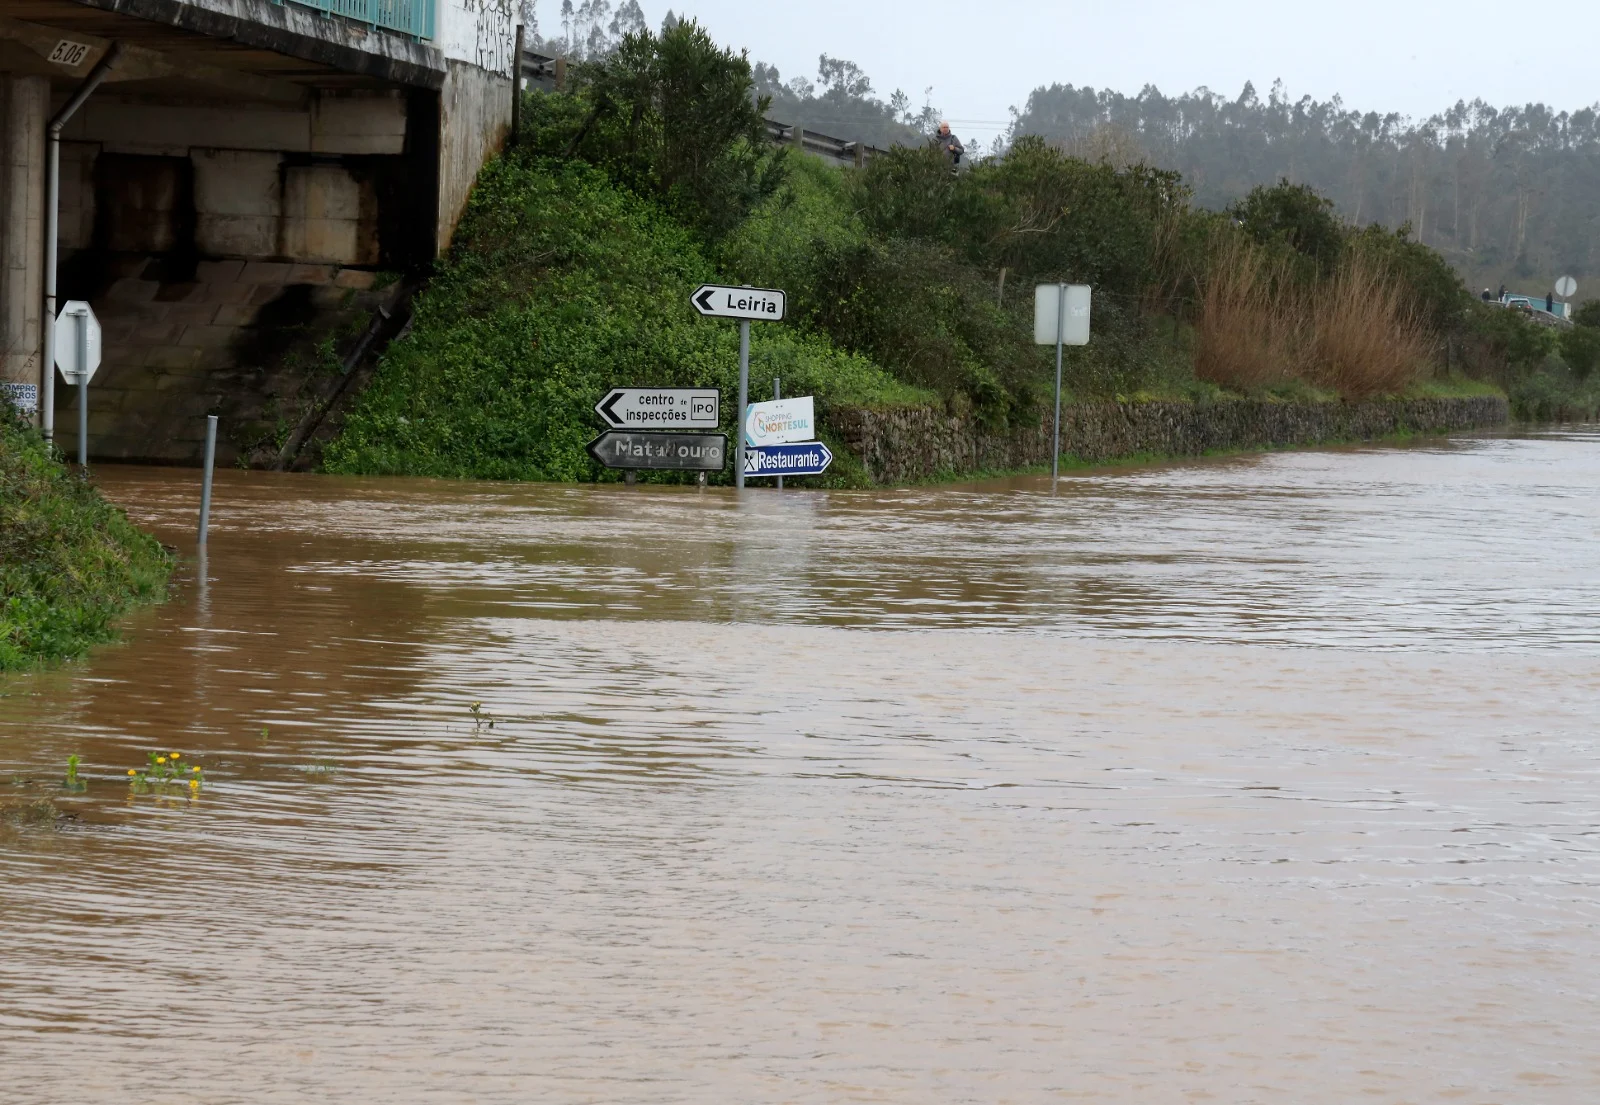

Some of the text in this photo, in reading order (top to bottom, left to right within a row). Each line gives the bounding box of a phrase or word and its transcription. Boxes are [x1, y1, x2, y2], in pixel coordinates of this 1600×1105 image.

[52, 42, 86, 64] 5.06
[727, 294, 776, 314] Leiria
[638, 393, 674, 405] centro
[693, 404, 714, 413] IPO
[626, 409, 687, 423] inspecções
[765, 412, 792, 422] SHOPPING
[765, 419, 809, 433] NORTESUL
[758, 450, 820, 469] Restaurante
